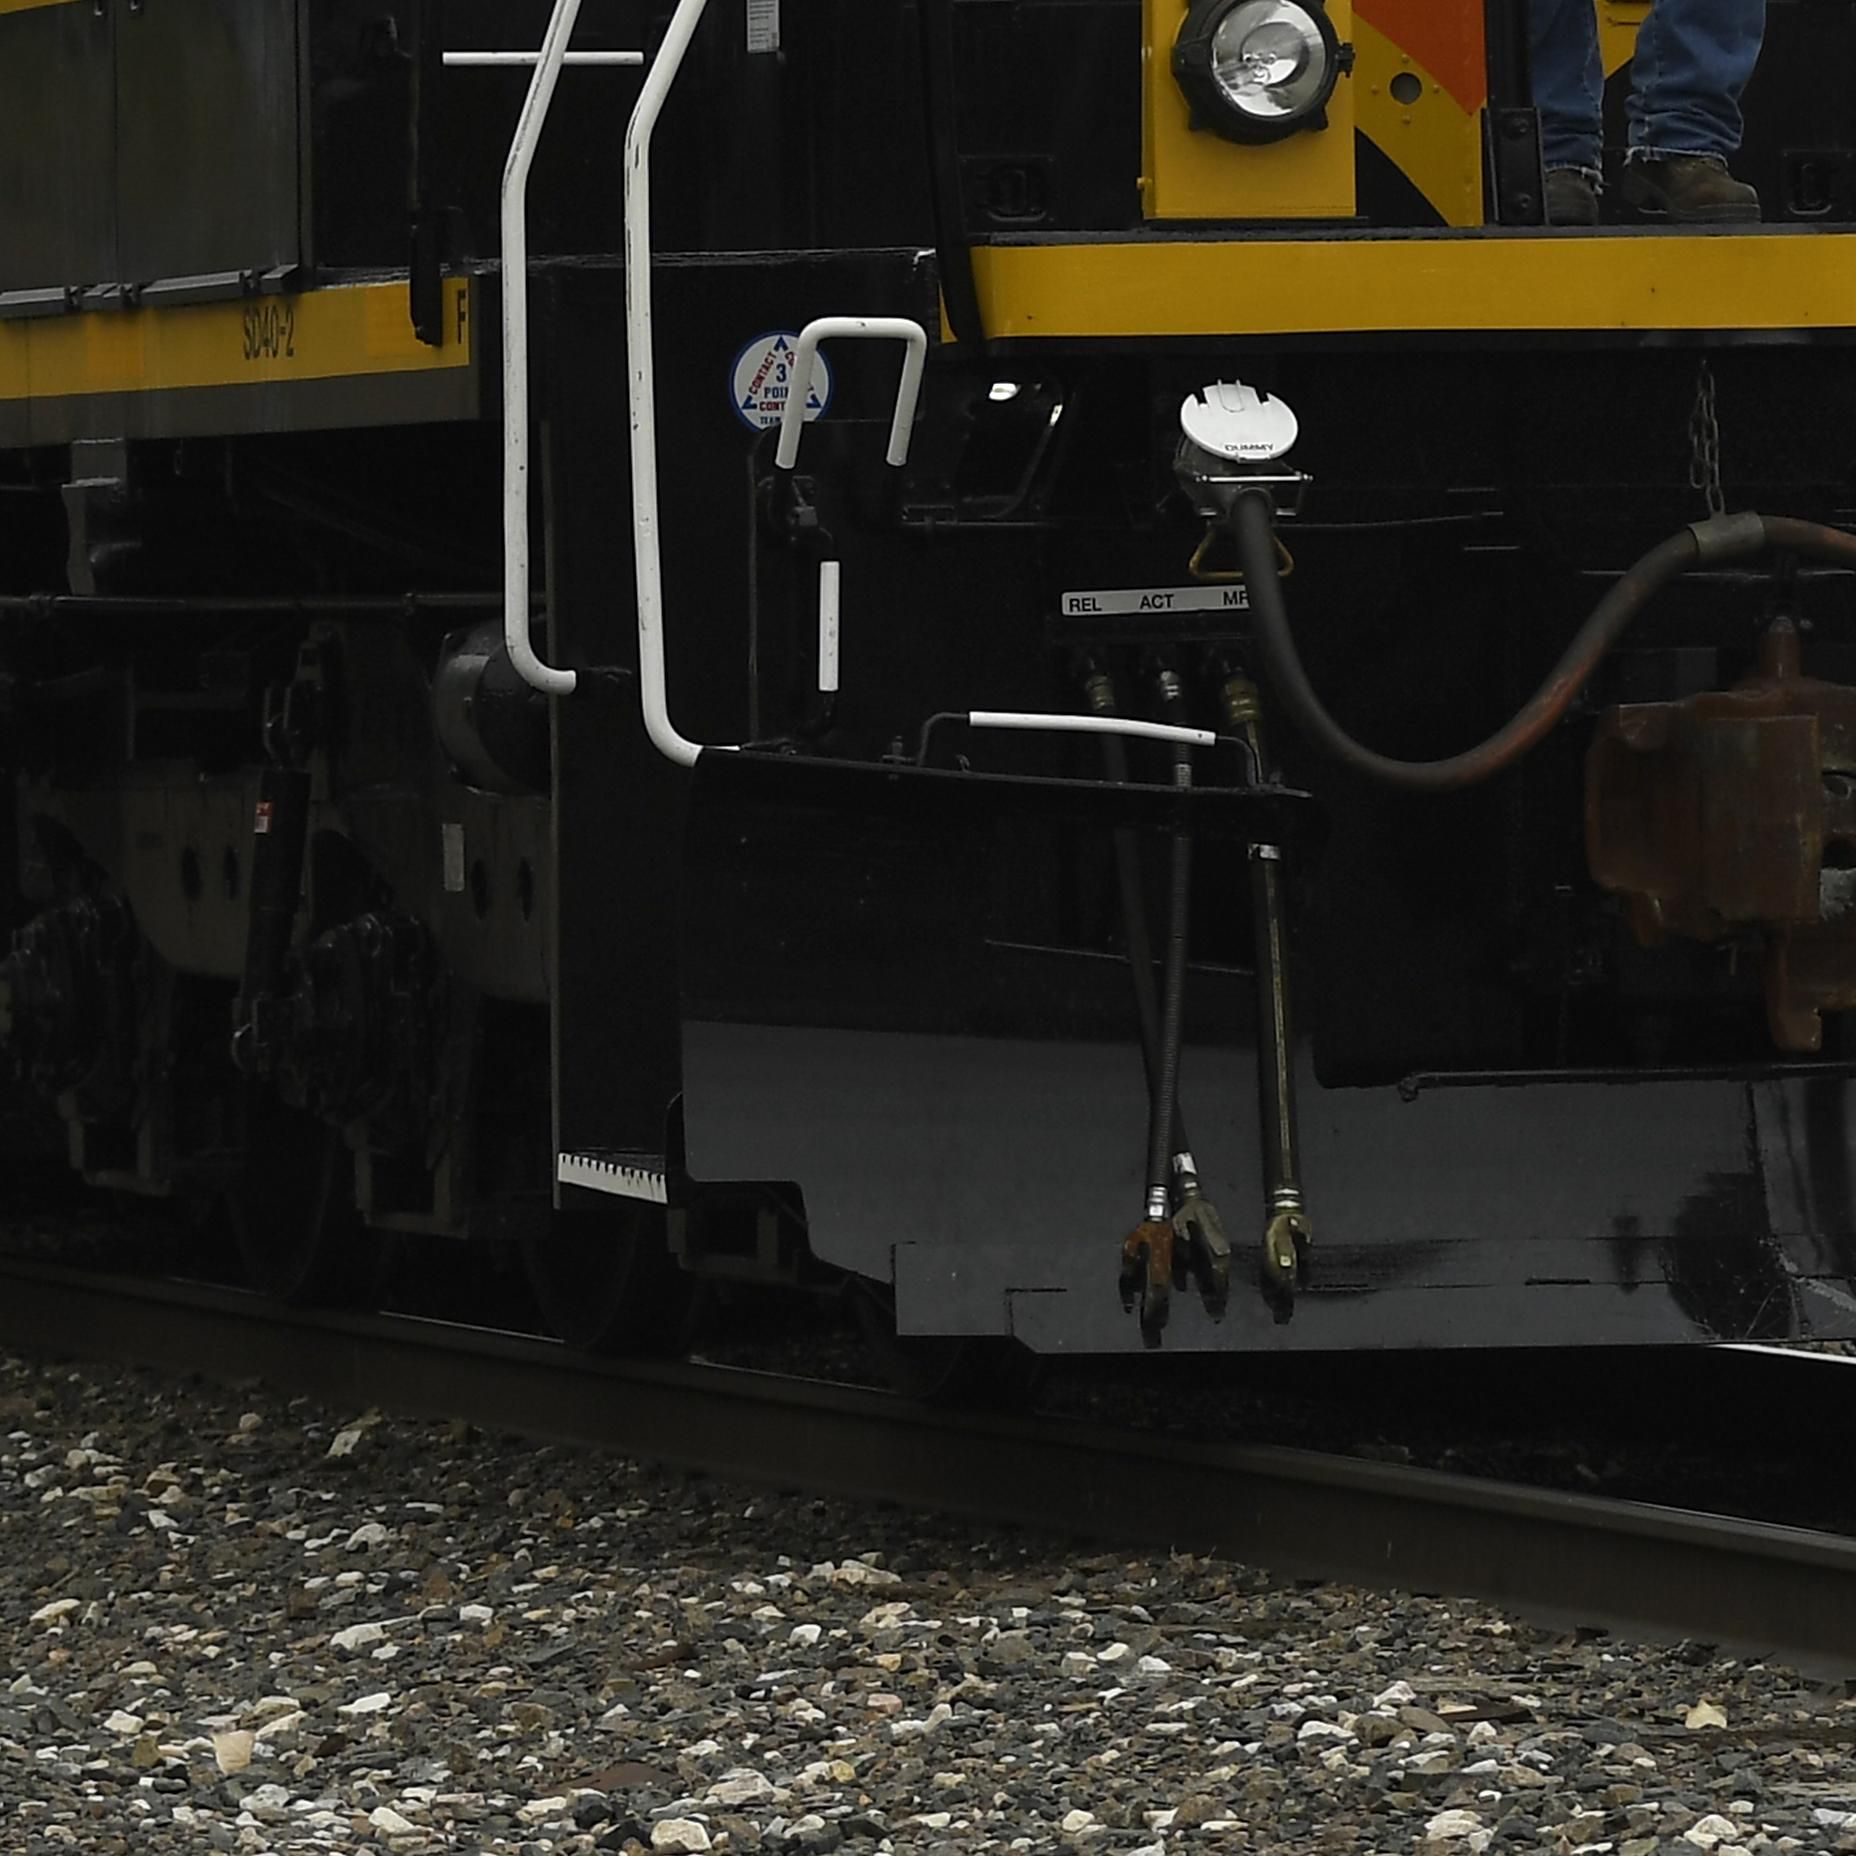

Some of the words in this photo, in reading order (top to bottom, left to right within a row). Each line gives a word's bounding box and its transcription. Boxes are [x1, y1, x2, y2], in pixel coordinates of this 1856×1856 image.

[244, 304, 294, 361] SD40-2
[457, 288, 467, 345] F
[748, 351, 777, 395] CONTACT
[775, 363, 787, 383] 3
[1068, 597, 1103, 613] REL
[1140, 593, 1175, 610] ACT
